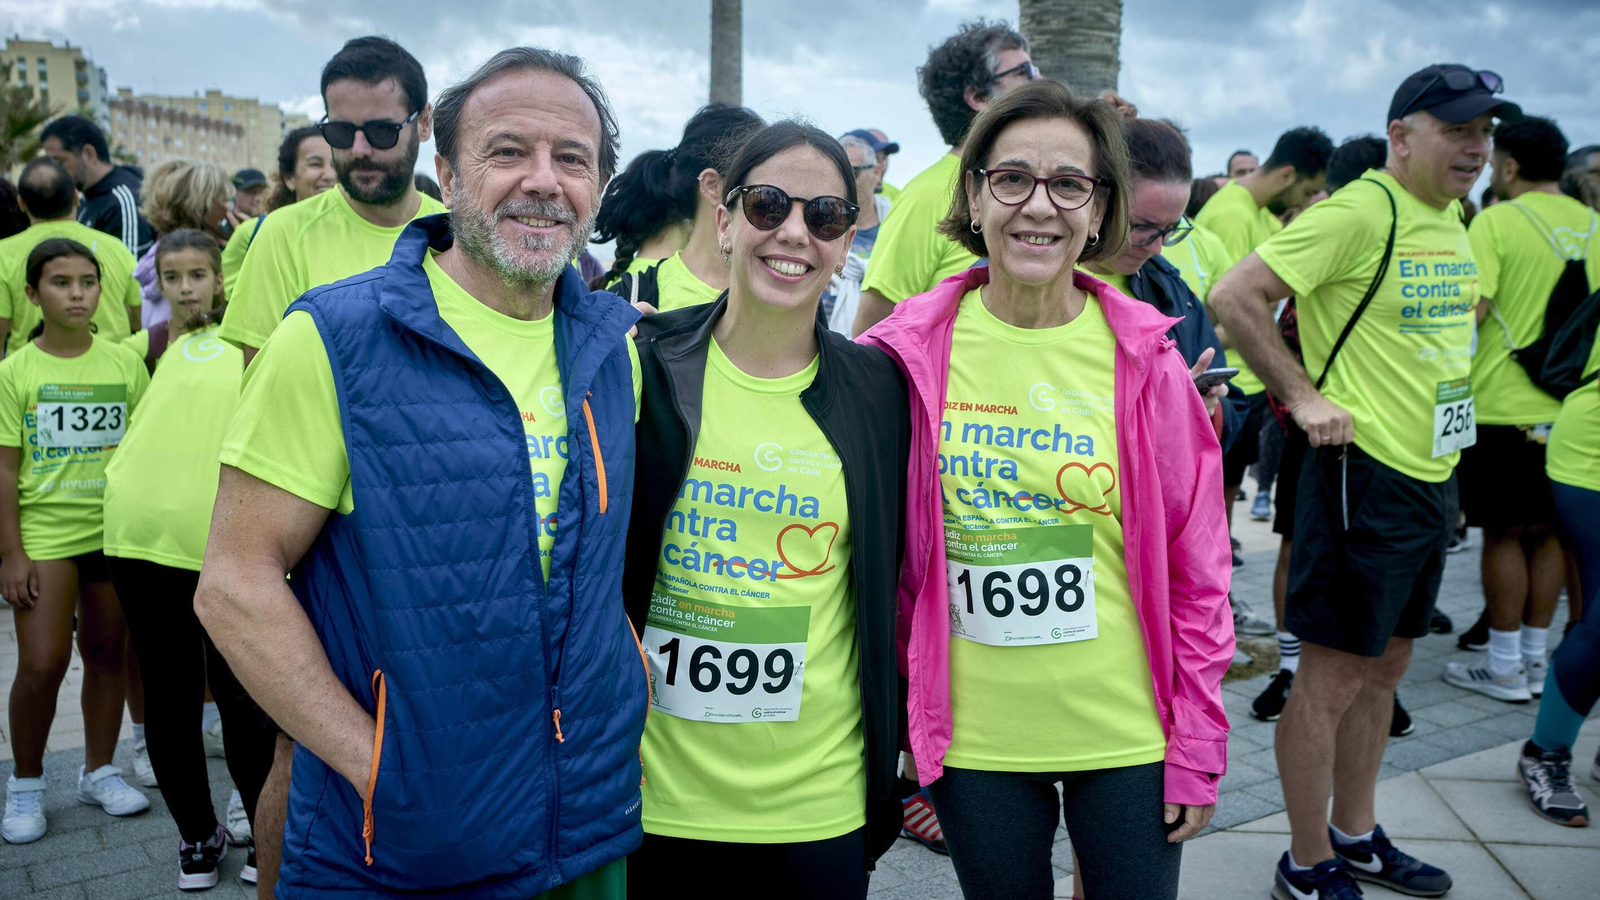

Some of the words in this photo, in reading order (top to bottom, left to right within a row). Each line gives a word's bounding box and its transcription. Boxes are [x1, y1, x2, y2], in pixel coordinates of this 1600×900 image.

[1399, 260, 1428, 278] En
[1401, 280, 1460, 298] contra
[1401, 301, 1423, 319] el
[51, 406, 122, 431] 1323
[960, 403, 973, 412] EN
[975, 404, 1018, 415] MARCHA
[25, 413, 37, 428] E
[961, 424, 1094, 457] marcha
[694, 457, 741, 473] MARCHA
[679, 478, 820, 519] marcha
[955, 481, 1066, 512] cáncer
[945, 529, 961, 540] ádiz
[962, 534, 974, 542] en
[976, 531, 1017, 542] marcha
[969, 542, 979, 552] el
[981, 542, 1018, 552] cáncer
[663, 541, 784, 582] cáncer
[664, 573, 698, 588] ESPAÑOLA
[699, 583, 729, 594] CONTRA
[730, 588, 739, 596] EL
[740, 589, 770, 599] CÁNCER
[957, 564, 1085, 618] 1698
[650, 604, 683, 619] contra
[685, 612, 695, 622] el
[697, 615, 736, 628] cáncer
[678, 601, 692, 610] en
[694, 604, 735, 618] marcha
[653, 614, 672, 624] CARRERA
[673, 618, 692, 627] CONTRA
[698, 623, 718, 633] CÁNCER
[659, 637, 794, 696] 1699
